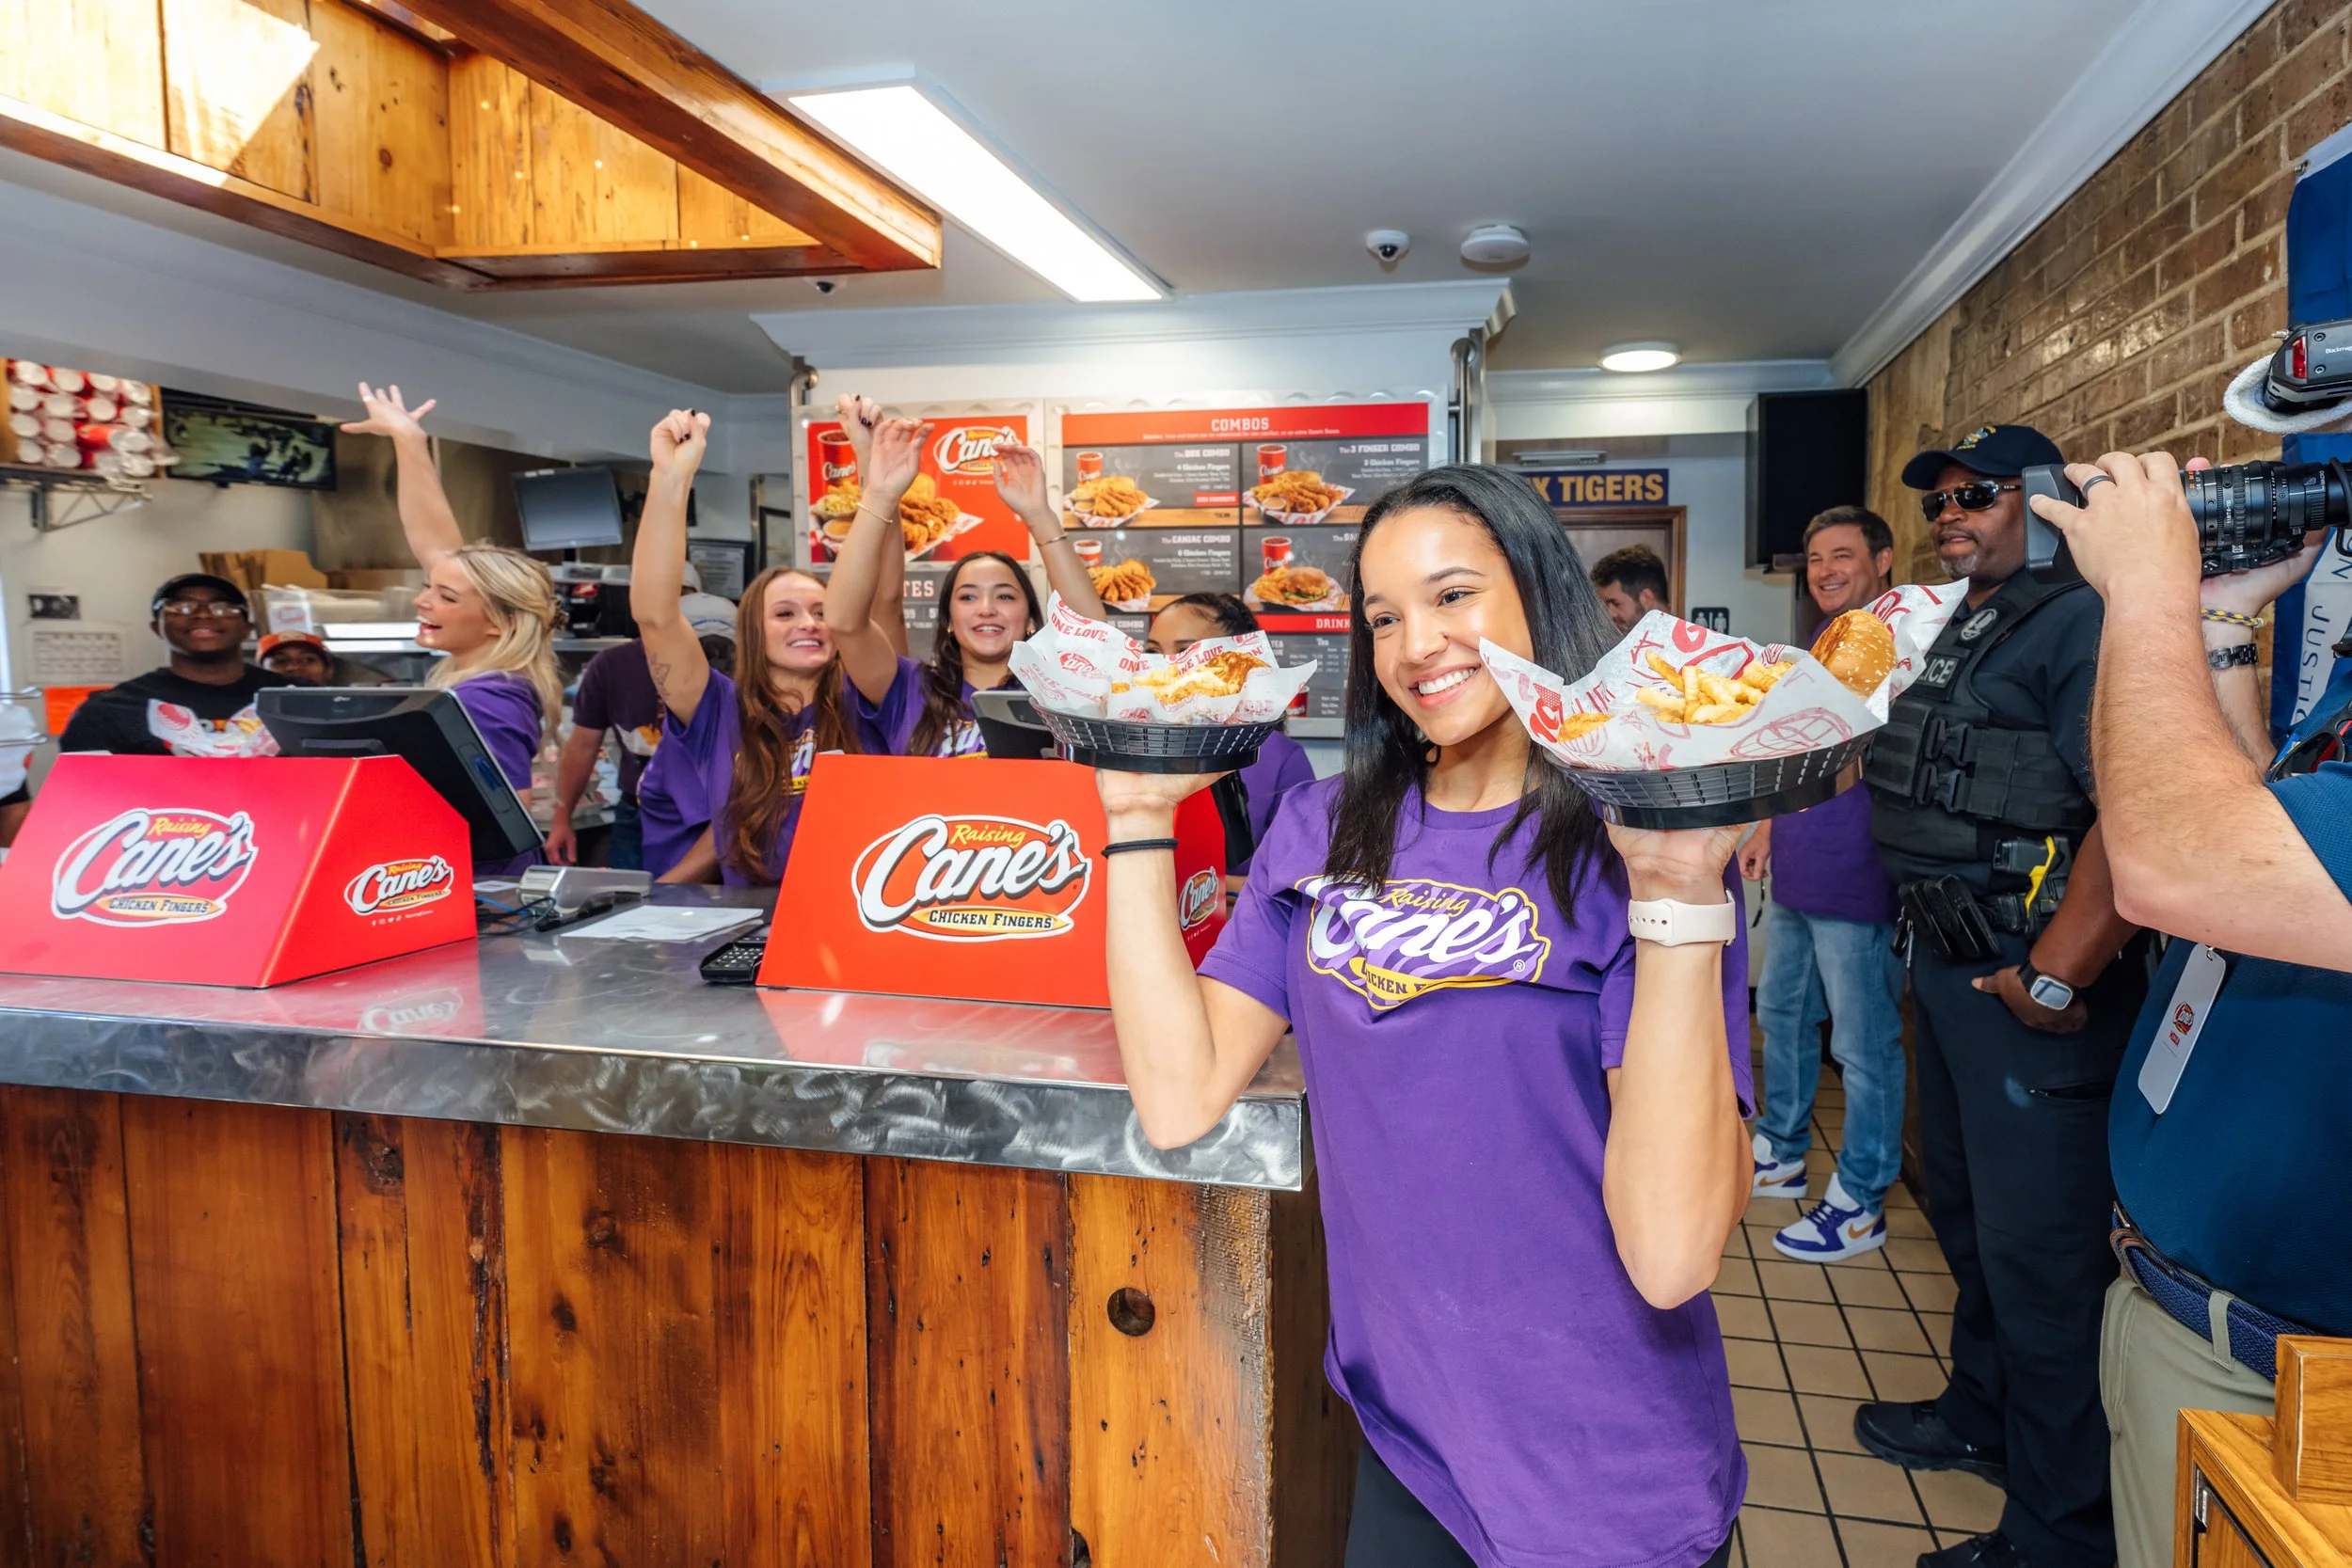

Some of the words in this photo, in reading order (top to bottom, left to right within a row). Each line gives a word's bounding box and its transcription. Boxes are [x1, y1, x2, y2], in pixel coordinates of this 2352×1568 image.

[1211, 418, 1270, 432] COMBOS
[1557, 474, 1664, 502] TIGERS
[1050, 611, 1072, 634] ONE
[1315, 618, 1351, 629] DRINK
[1918, 657, 1955, 685] LICE
[147, 816, 213, 839] Raising
[948, 823, 1028, 847] Raising
[57, 810, 256, 915] Cane's
[388, 863, 423, 876] Raising
[860, 817, 1088, 926] Cane's
[352, 857, 452, 913] Cane's
[1180, 866, 1217, 929] Cane's
[1379, 887, 1470, 917] Raising
[929, 910, 989, 927] CHICKEN
[993, 911, 1053, 930] FINGERS
[1363, 966, 1409, 995] ICKEN
